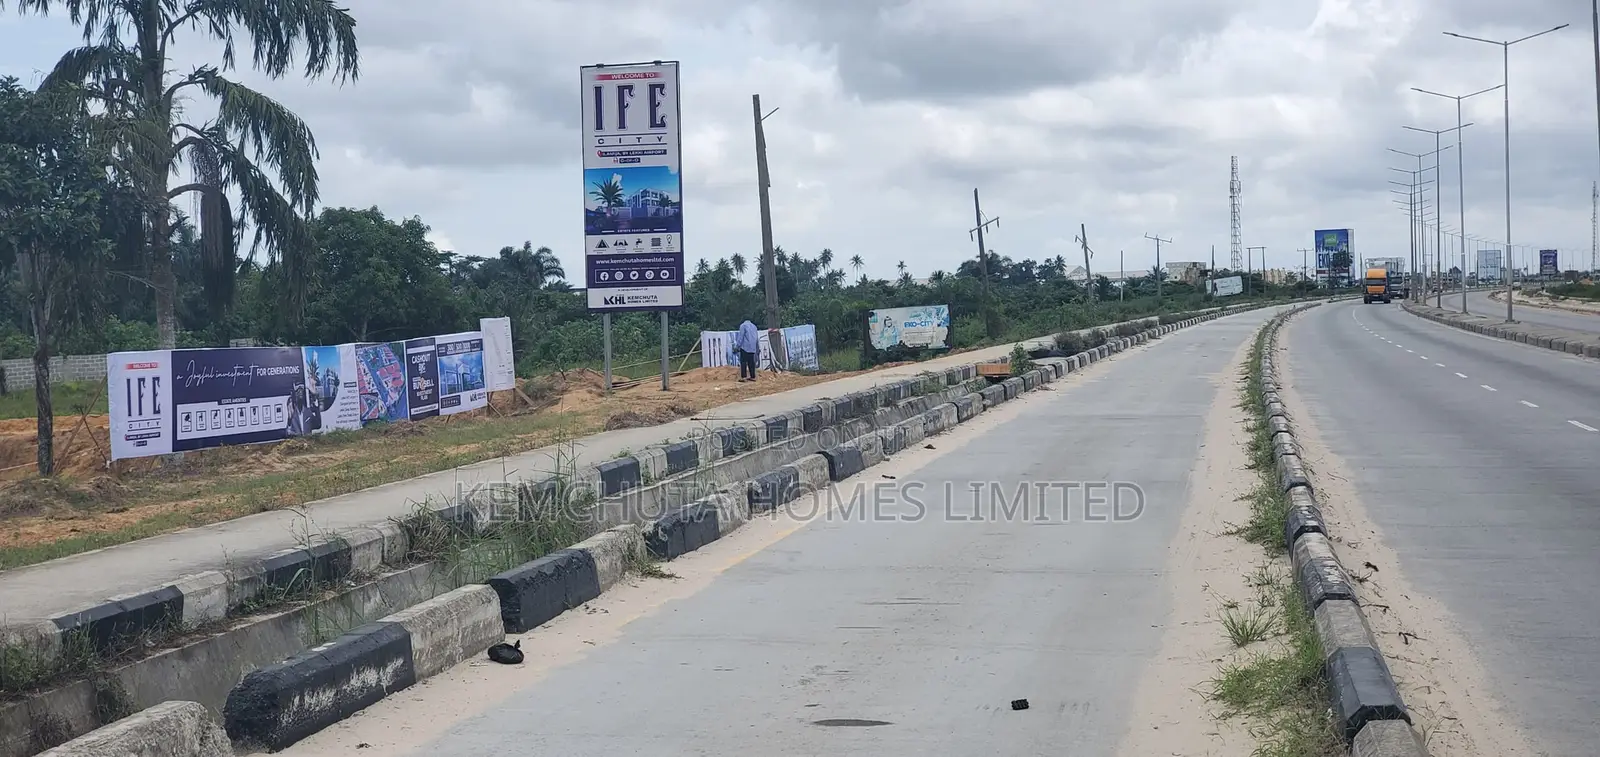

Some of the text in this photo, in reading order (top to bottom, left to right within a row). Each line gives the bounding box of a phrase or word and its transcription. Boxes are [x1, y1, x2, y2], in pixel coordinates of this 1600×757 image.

[594, 83, 666, 131] IFE
[597, 136, 663, 145] CITY
[595, 256, 675, 265] www.kemchutahomesltd.com
[411, 353, 431, 364] CASHOUT
[215, 363, 259, 387] investment
[256, 367, 267, 377] FOR
[267, 365, 300, 376] GENERATIONS
[126, 376, 161, 417] IFE
[128, 421, 160, 429] CITY
